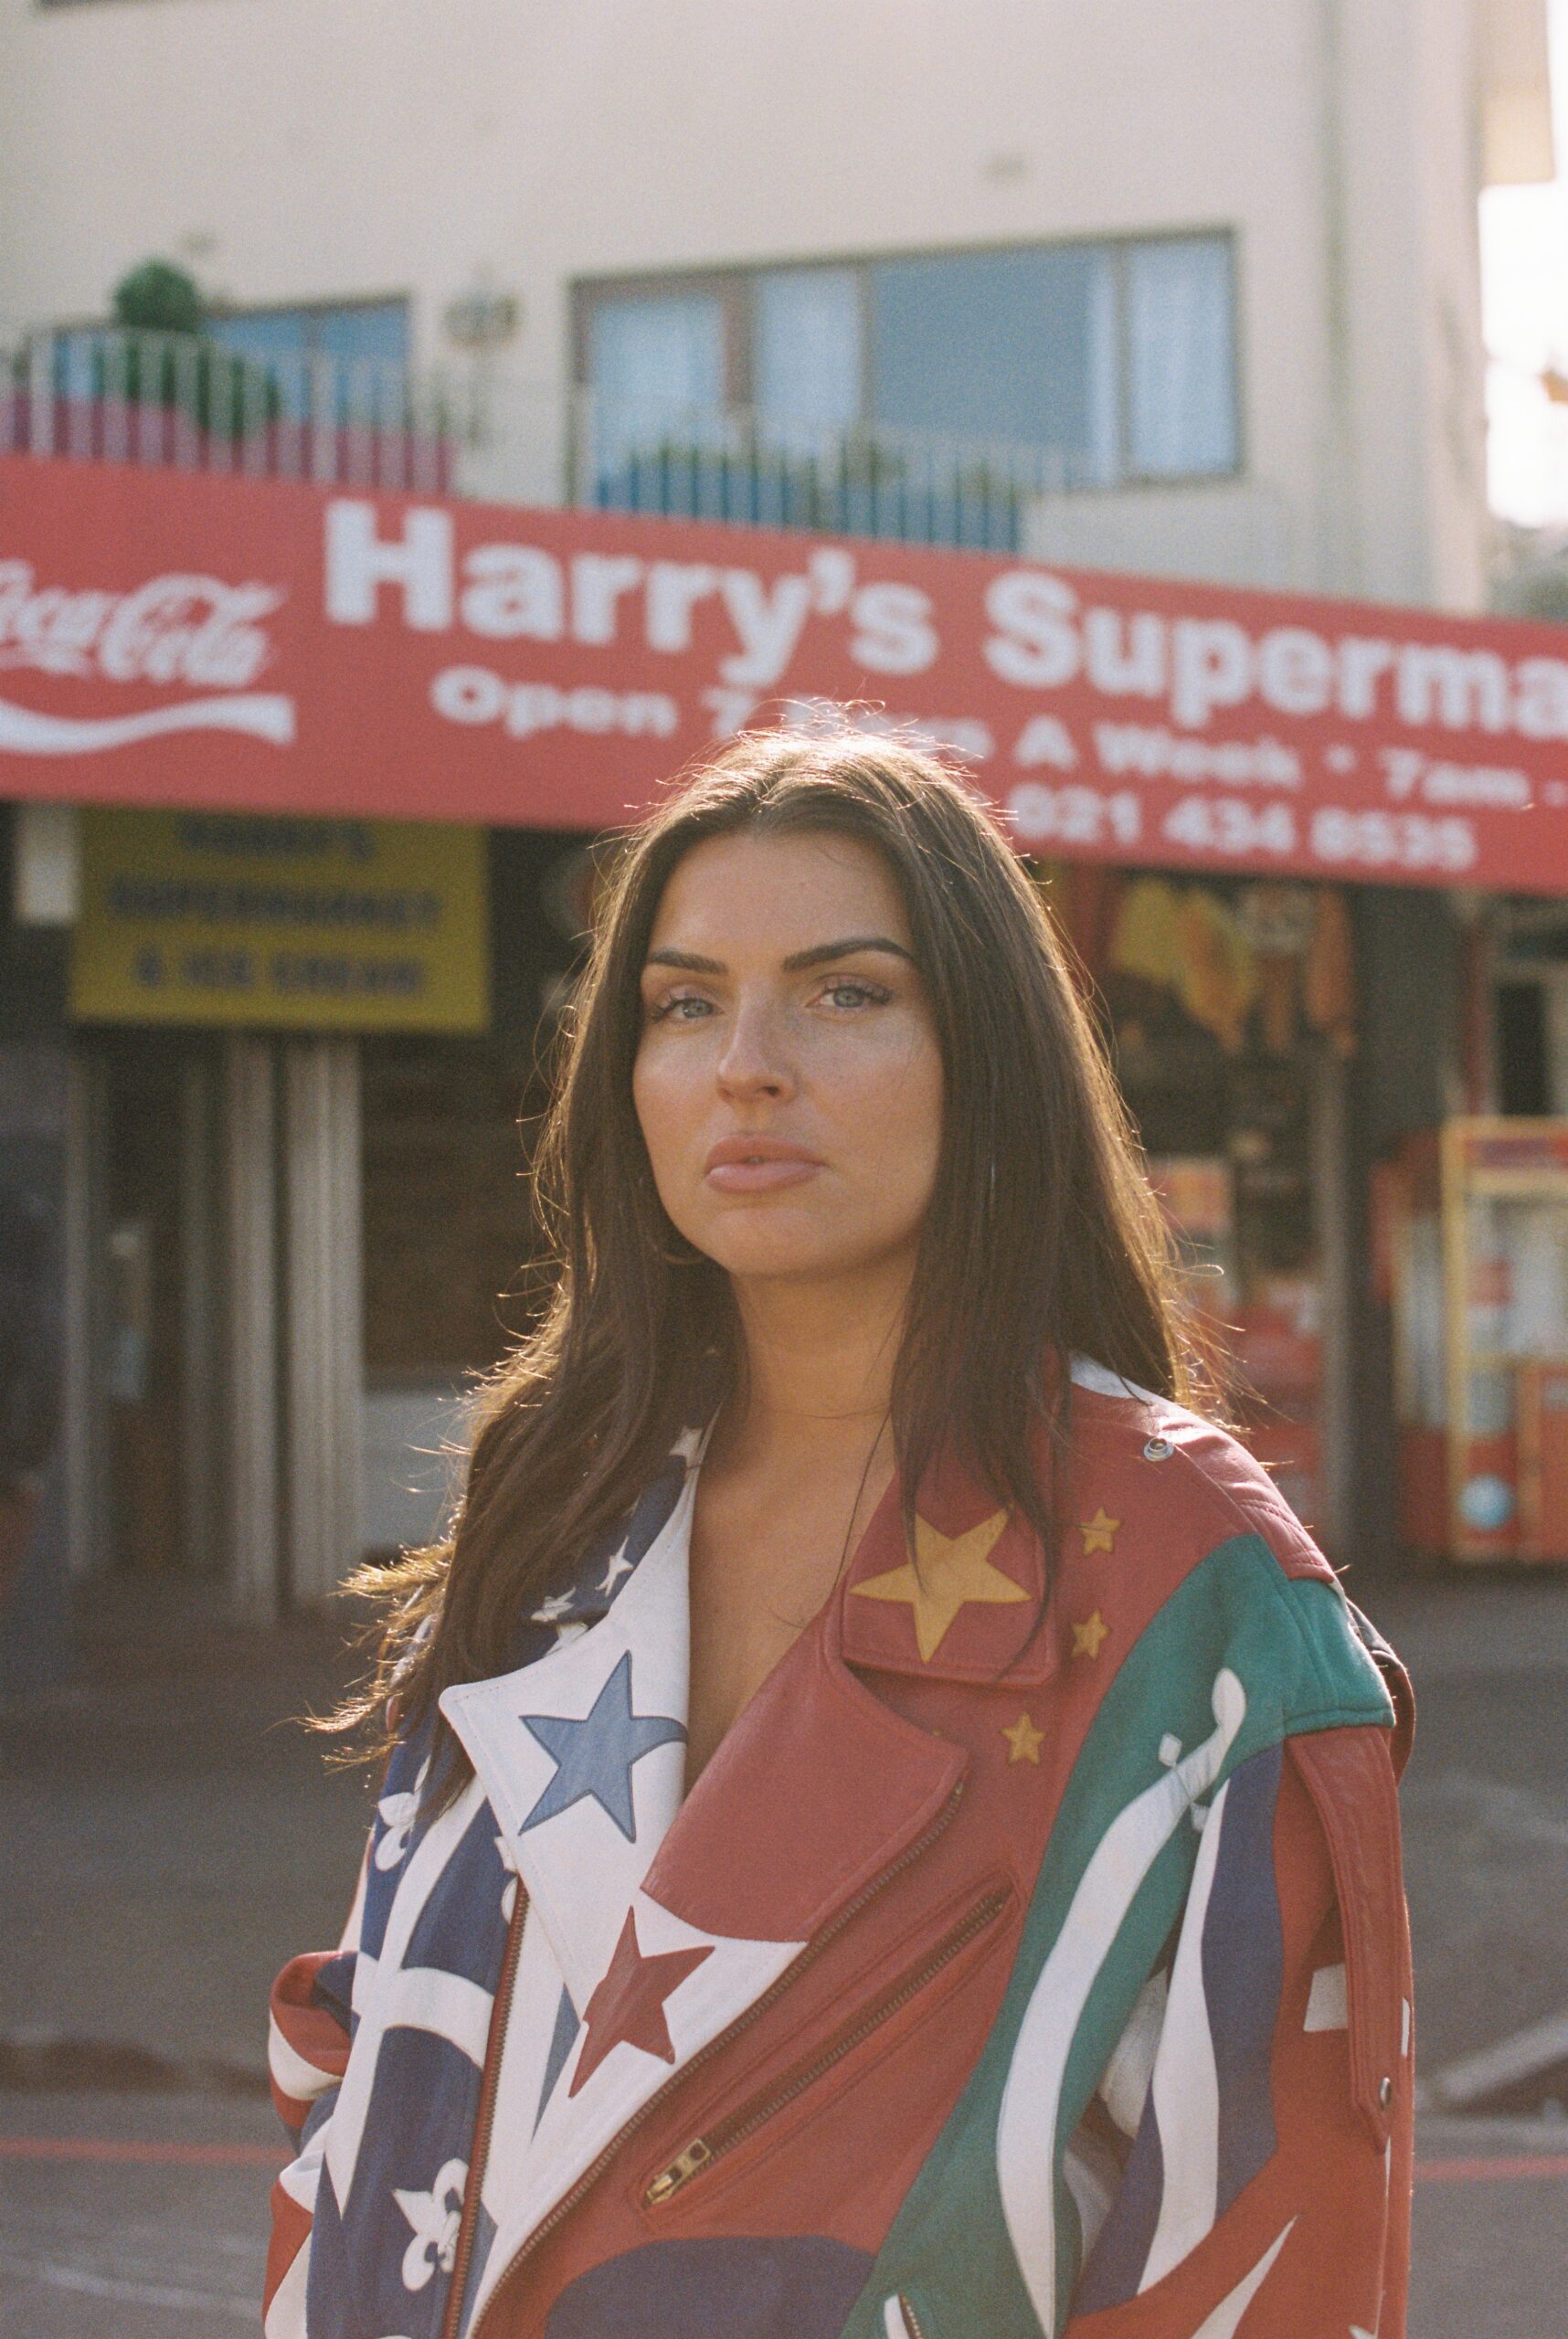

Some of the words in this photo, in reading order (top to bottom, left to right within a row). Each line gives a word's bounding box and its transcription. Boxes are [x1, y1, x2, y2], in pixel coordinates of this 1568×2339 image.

[0, 558, 284, 689] oca-Cola
[323, 497, 939, 688] Harry's
[430, 664, 680, 742] Open
[1012, 714, 1078, 771] A
[1094, 722, 1303, 790] Week
[1162, 795, 1298, 855] 434
